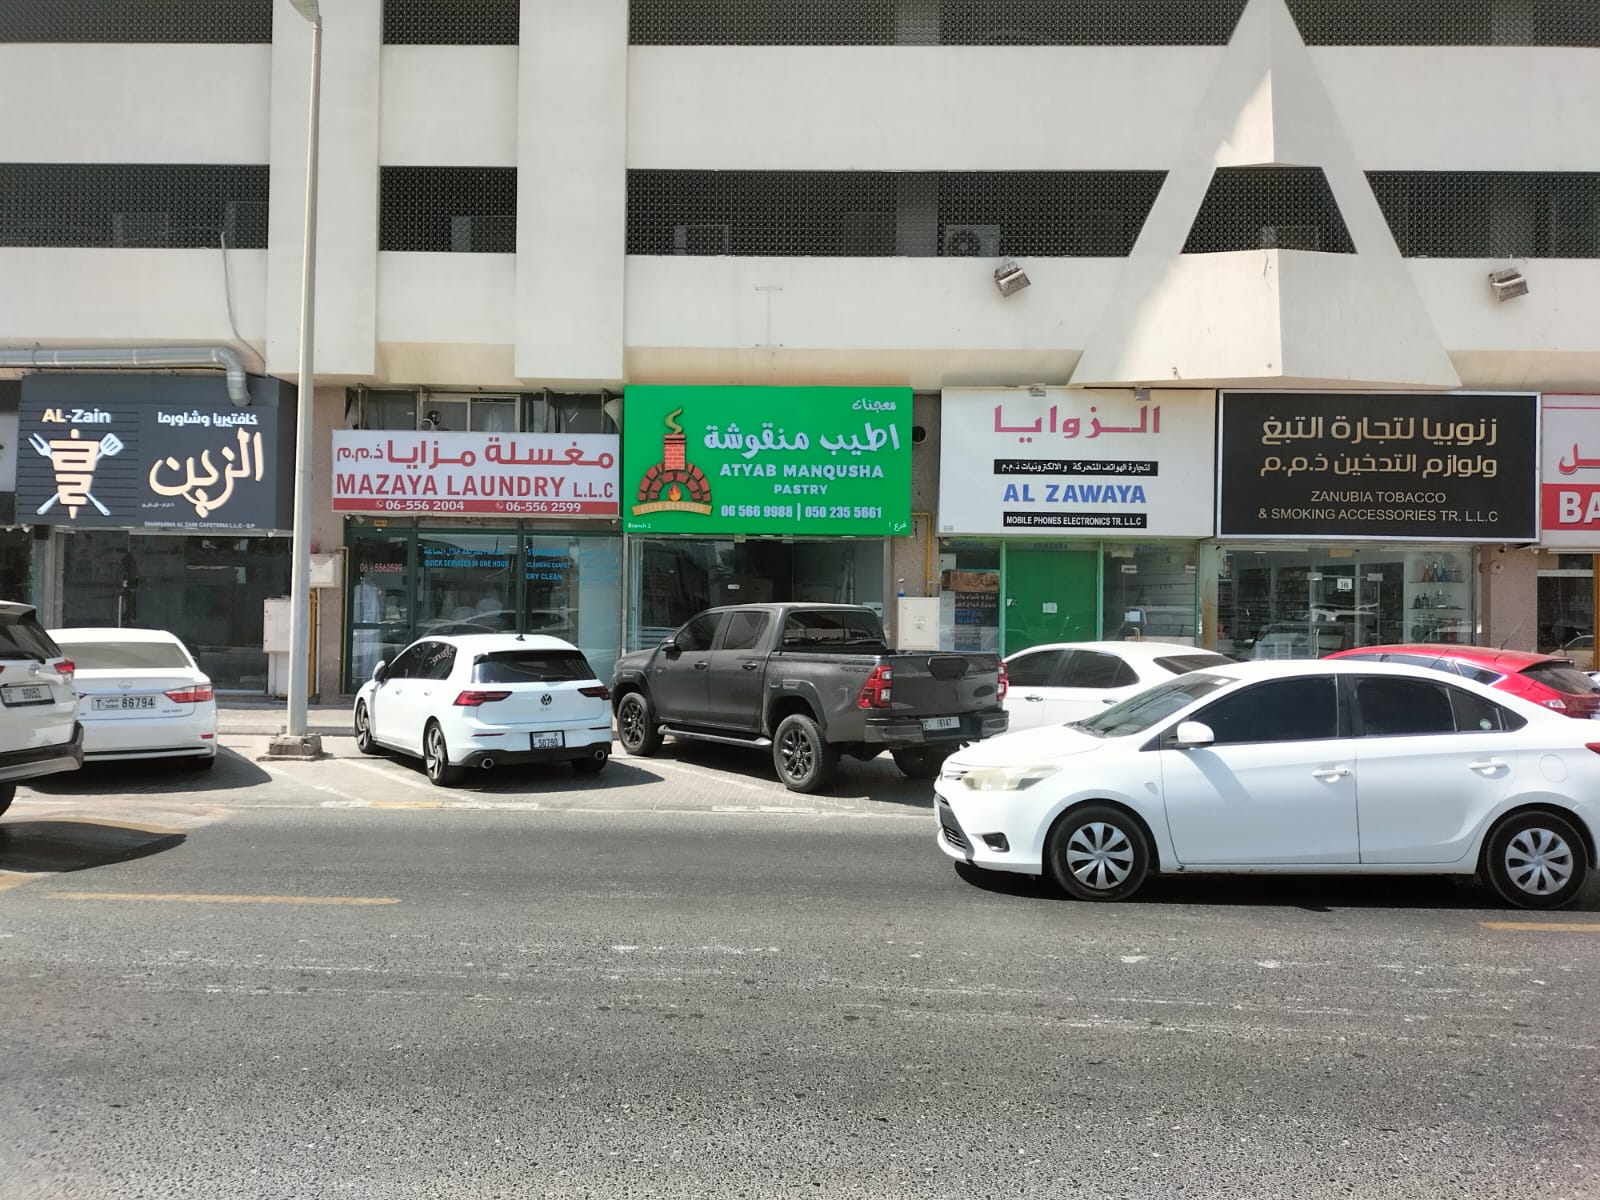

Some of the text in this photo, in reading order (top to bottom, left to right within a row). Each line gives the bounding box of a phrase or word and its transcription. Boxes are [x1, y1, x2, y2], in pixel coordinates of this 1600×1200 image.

[41, 408, 111, 423] AL-Zain
[157, 411, 210, 427] وشاورما
[994, 404, 1160, 443] الزوايا
[1261, 416, 1497, 446] زنوبيا لتجارة التبغ
[703, 422, 809, 459] منقوشة
[336, 436, 614, 470] مغسلة مزايا ذ.م.م
[150, 427, 265, 518] الزين
[719, 463, 884, 480] ATYAB MANQUSHA
[1128, 462, 1151, 473] لتجارة
[1259, 453, 1497, 478] ولوازم التدخين ذ.م.م
[336, 473, 613, 498] MAZAYA LAUNDRY L.L.C
[774, 484, 829, 495] PASTRY
[1003, 484, 1147, 503] AL ZAWAYA
[1311, 491, 1446, 504] ZANUBIA TOBACCO
[385, 500, 465, 512] 06-556 2004
[505, 501, 581, 514] 06-556 2599
[721, 505, 736, 517] 06
[763, 505, 793, 518] 9988
[805, 506, 827, 518] 050
[829, 507, 851, 519] 235
[1006, 516, 1033, 525] MOBILE
[1033, 516, 1062, 525] PHONES
[1063, 516, 1111, 526] ELECTRONICS
[1258, 508, 1498, 523] & SMOKING ACCESSORIES TR. L.L.C
[121, 697, 154, 709] 86794
